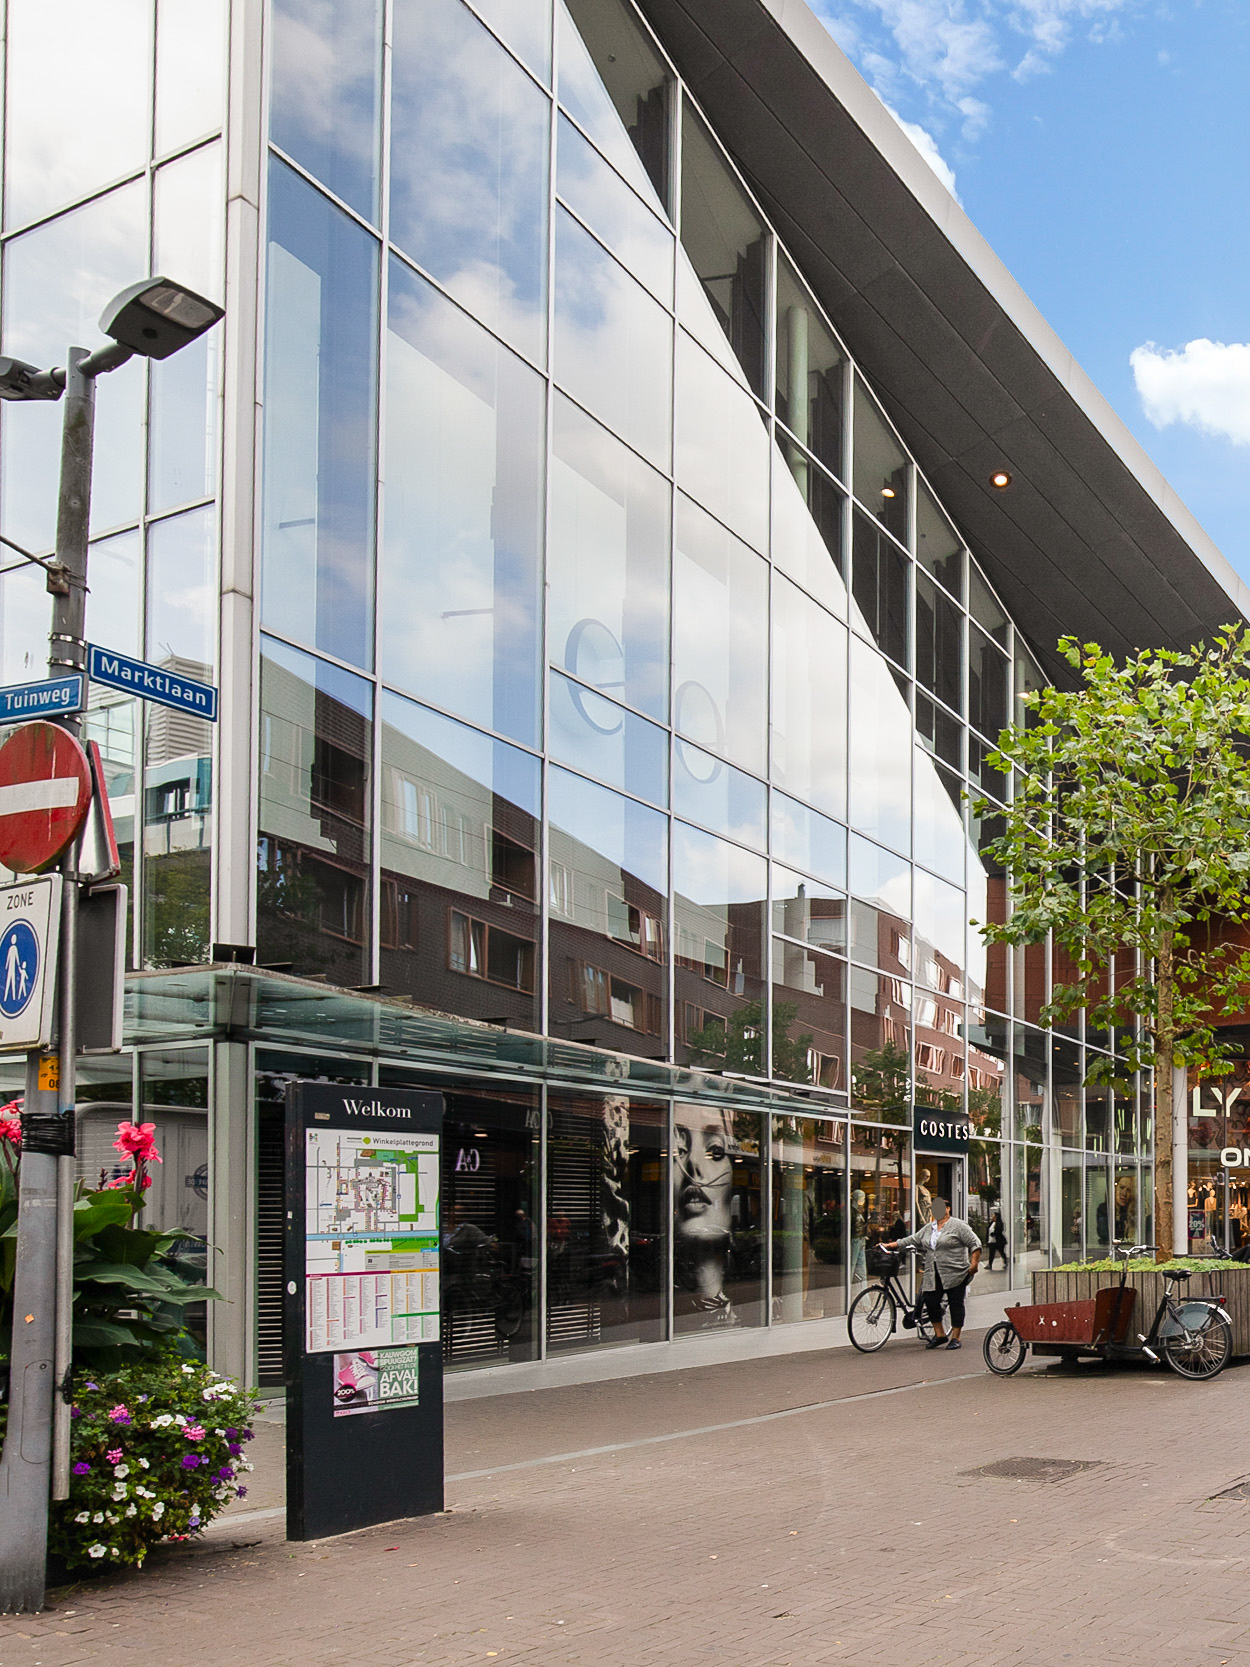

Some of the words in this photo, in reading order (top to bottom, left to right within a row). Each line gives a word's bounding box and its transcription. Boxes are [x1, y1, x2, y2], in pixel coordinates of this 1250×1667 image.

[101, 656, 206, 706] Marktlaan
[5, 686, 71, 710] Tuinweg
[6, 891, 34, 911] ZONE
[341, 1098, 412, 1118] Welkom
[920, 1119, 969, 1140] COSTES
[372, 1137, 434, 1148] Winkelplattegrond
[380, 1349, 417, 1360] KAUWGOM
[380, 1368, 418, 1384] AFVAL
[380, 1379, 418, 1398] BAK!
